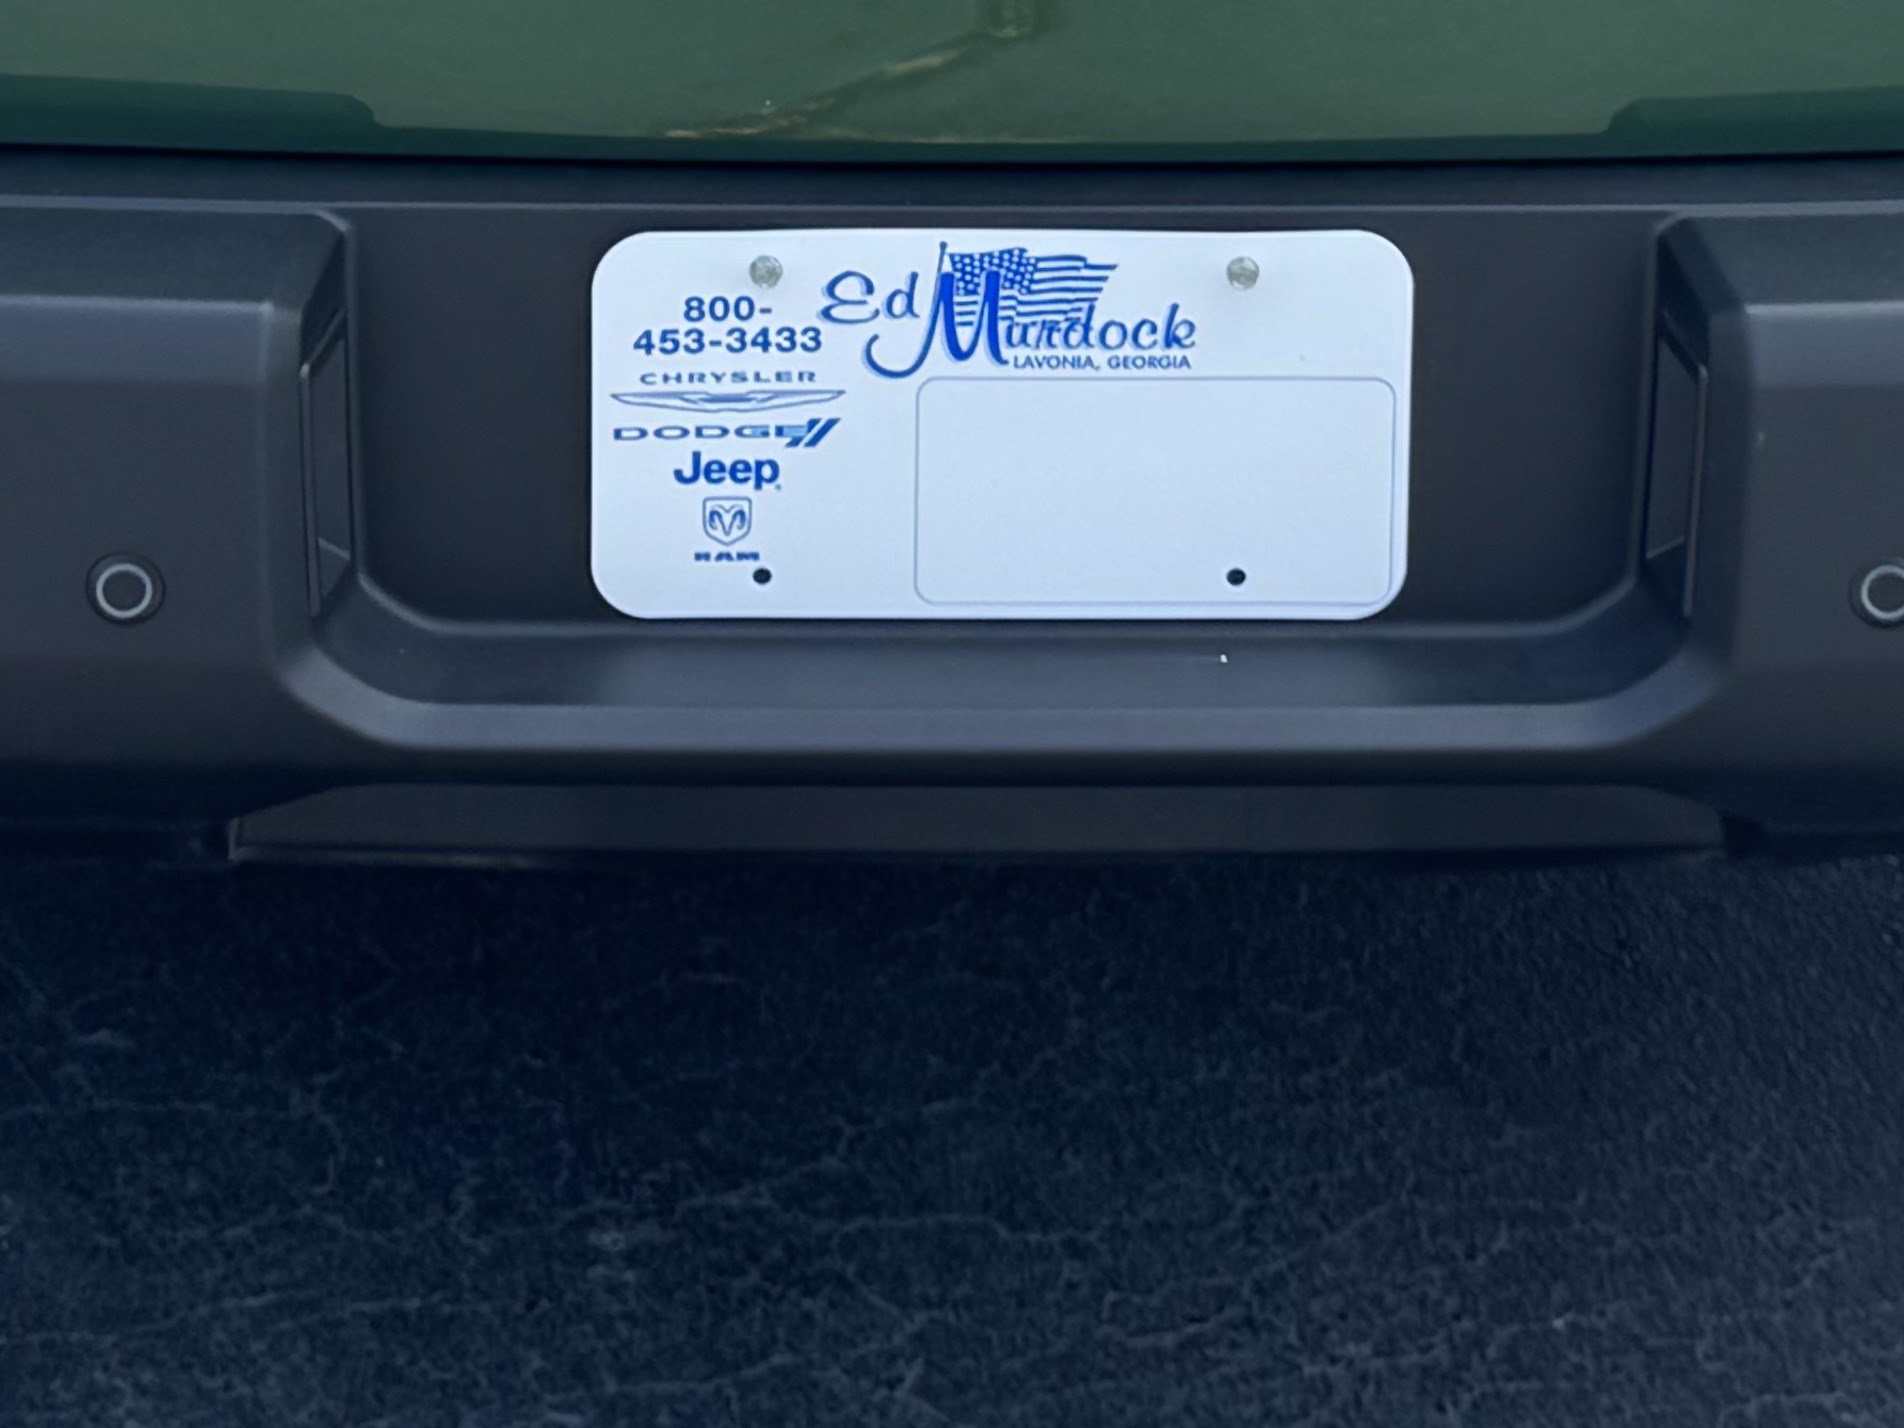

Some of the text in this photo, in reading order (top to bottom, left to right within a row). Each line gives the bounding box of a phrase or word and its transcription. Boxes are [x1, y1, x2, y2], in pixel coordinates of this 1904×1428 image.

[683, 295, 773, 322] 800-
[817, 266, 1197, 379] Ed Murdock
[632, 326, 823, 356] 453-3433
[1013, 354, 1192, 372] LAVONIA, GEORGIA
[639, 370, 817, 386] CHRYSLER
[613, 423, 812, 442] DODGE
[673, 449, 780, 491] Jeep
[694, 551, 760, 562] RAM
